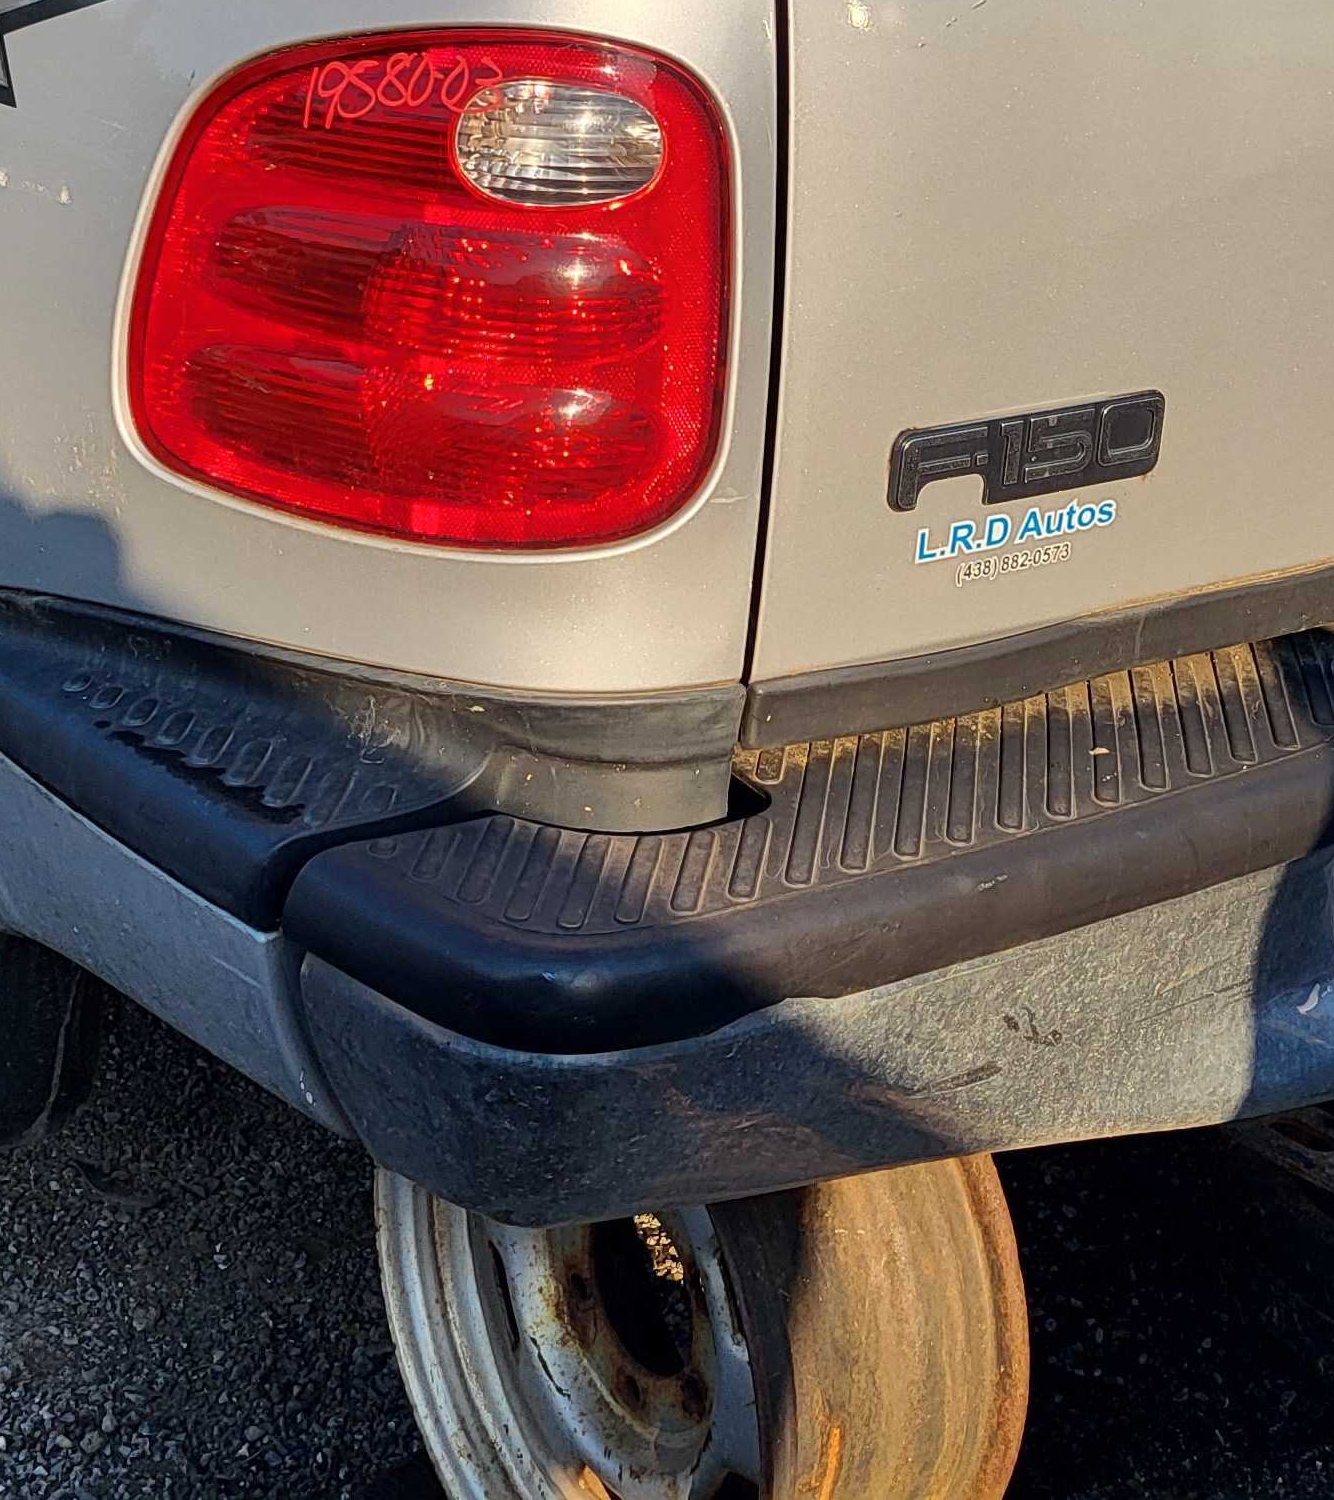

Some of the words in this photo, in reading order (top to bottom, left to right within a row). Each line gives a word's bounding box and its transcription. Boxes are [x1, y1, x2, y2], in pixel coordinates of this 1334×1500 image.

[916, 514, 1009, 562] L.R.D
[1018, 500, 1115, 544] Autos
[955, 552, 998, 587] (438)
[1000, 543, 1071, 573] 882-0573
